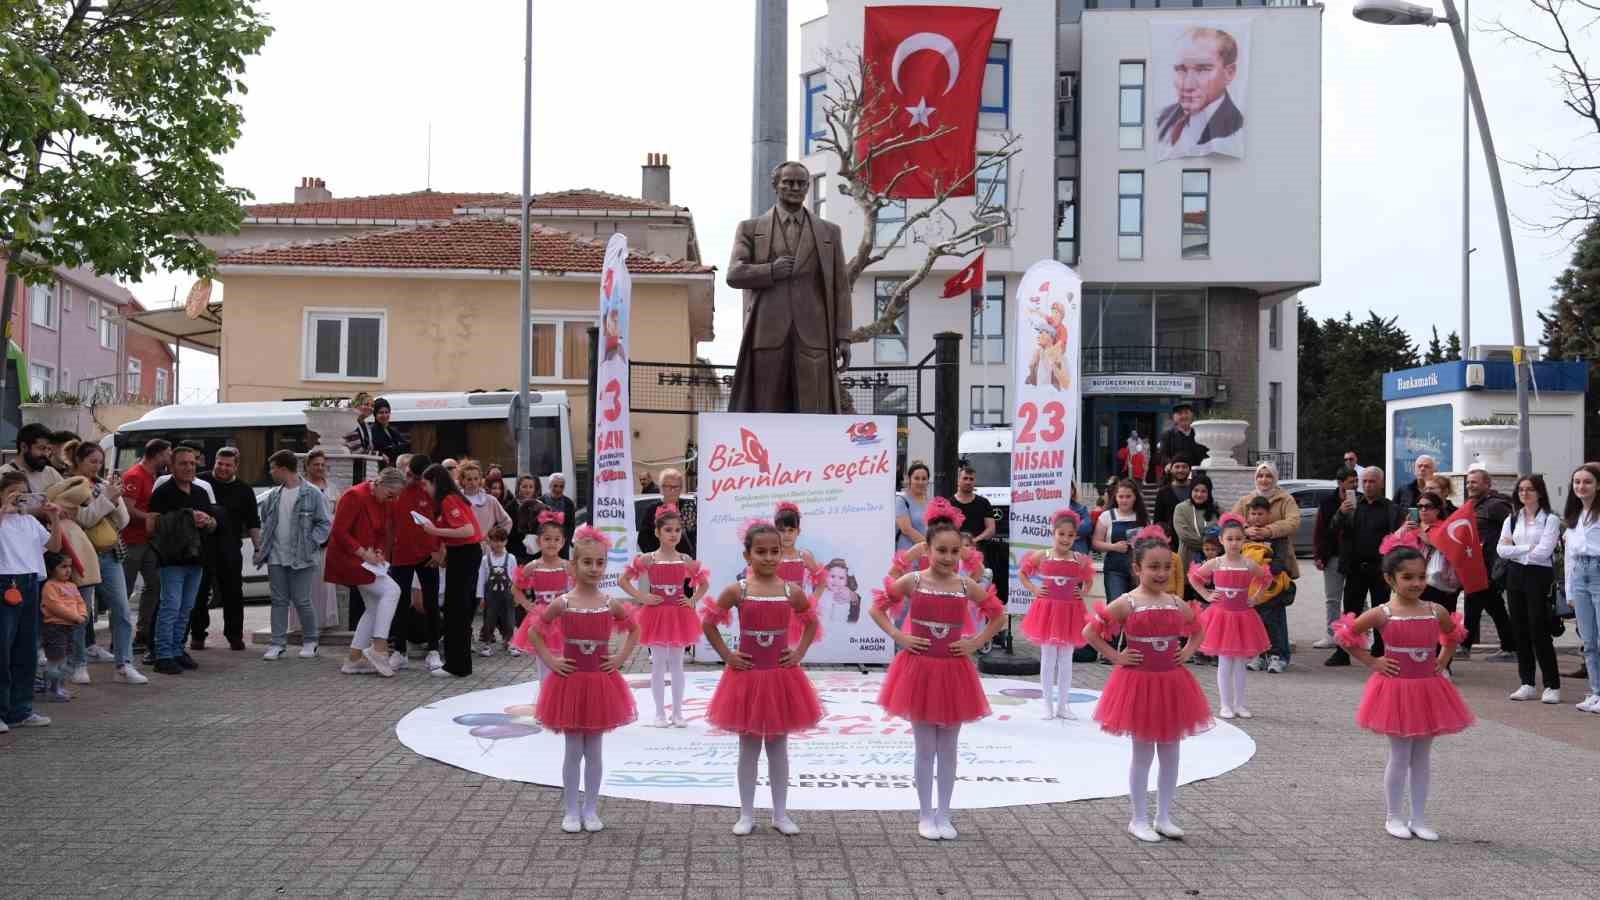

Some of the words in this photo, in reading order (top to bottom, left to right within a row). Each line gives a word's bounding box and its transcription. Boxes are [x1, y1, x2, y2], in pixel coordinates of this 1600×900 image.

[1397, 372, 1439, 391] Bankamatik
[1016, 401, 1066, 443] 23
[708, 444, 746, 472] Biz
[1013, 446, 1065, 471] NİSAN
[705, 463, 812, 501] yarınları
[823, 450, 889, 484] seçtik
